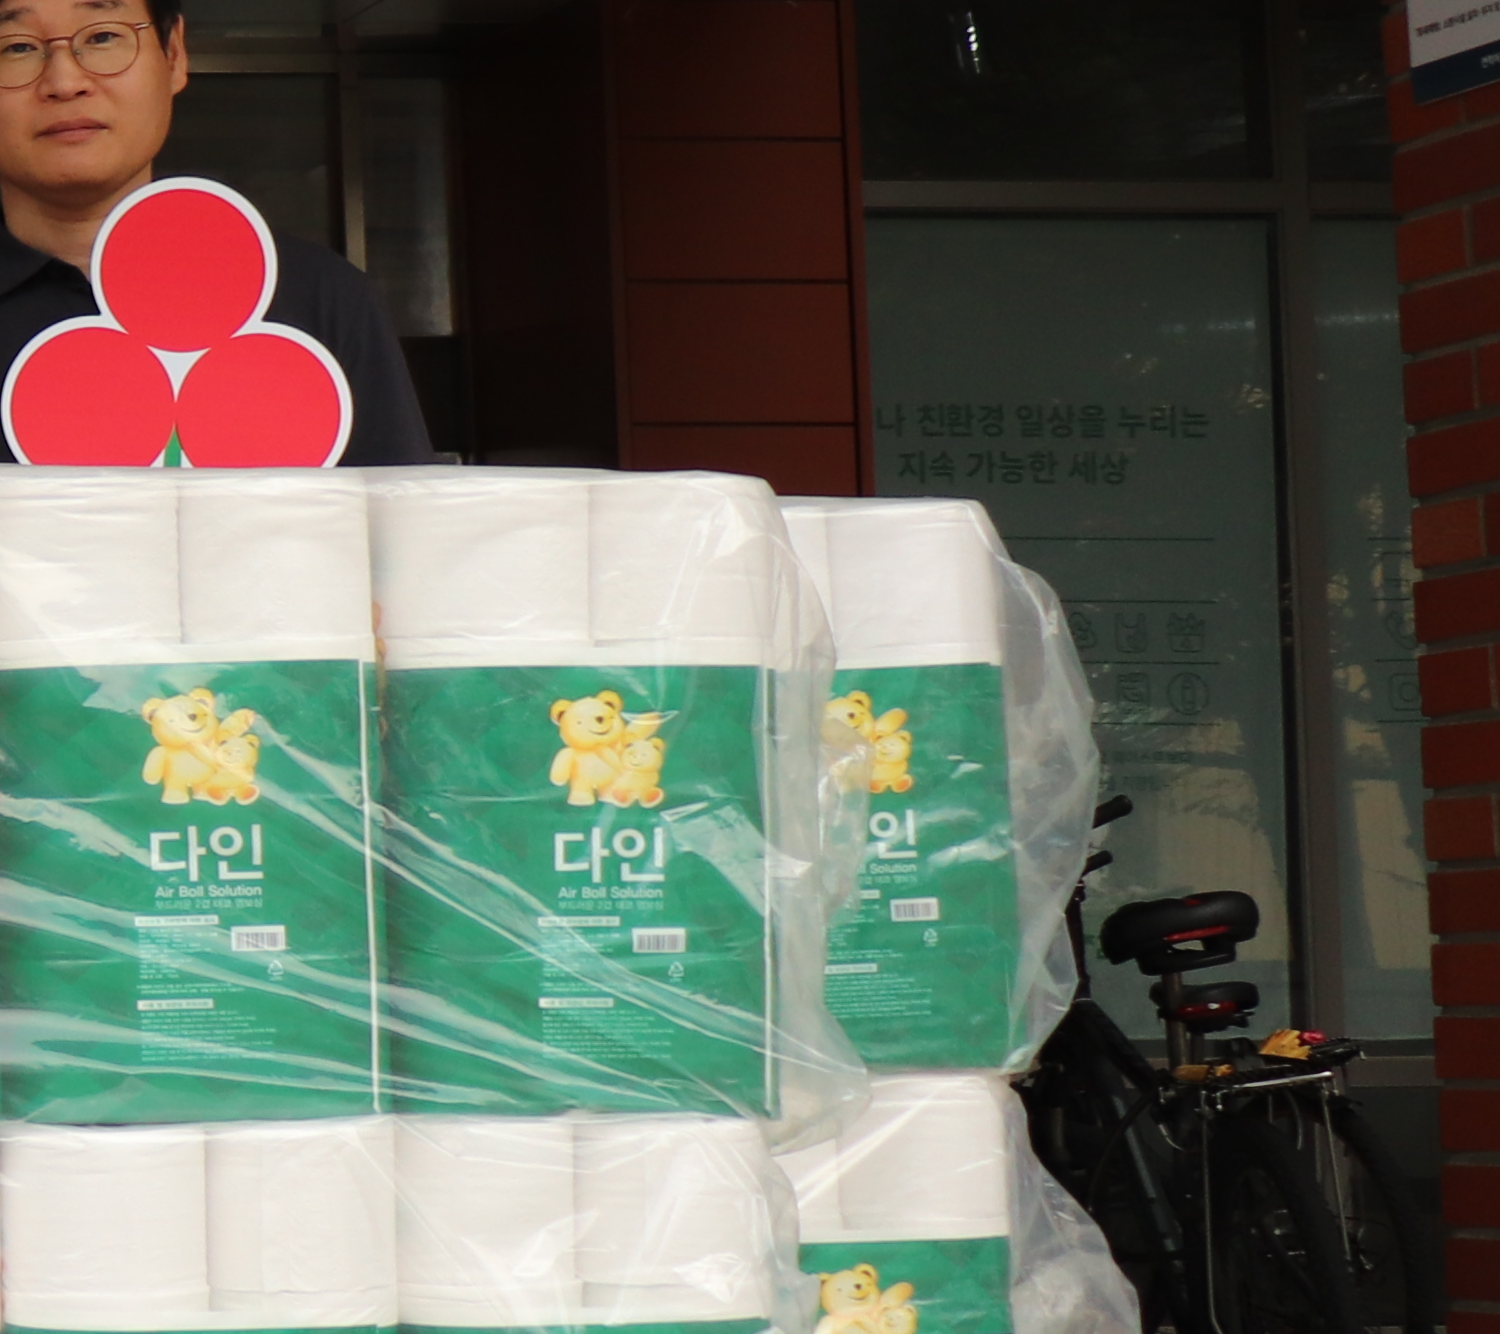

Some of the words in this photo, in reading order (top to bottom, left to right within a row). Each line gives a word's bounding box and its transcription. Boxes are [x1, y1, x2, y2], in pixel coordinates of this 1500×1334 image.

[1015, 403, 1105, 438] 일상을
[898, 450, 955, 485] 지속
[966, 451, 1058, 485] 가능한
[1069, 451, 1130, 485] 세상
[149, 824, 265, 884] 다인
[554, 825, 667, 884] 다인
